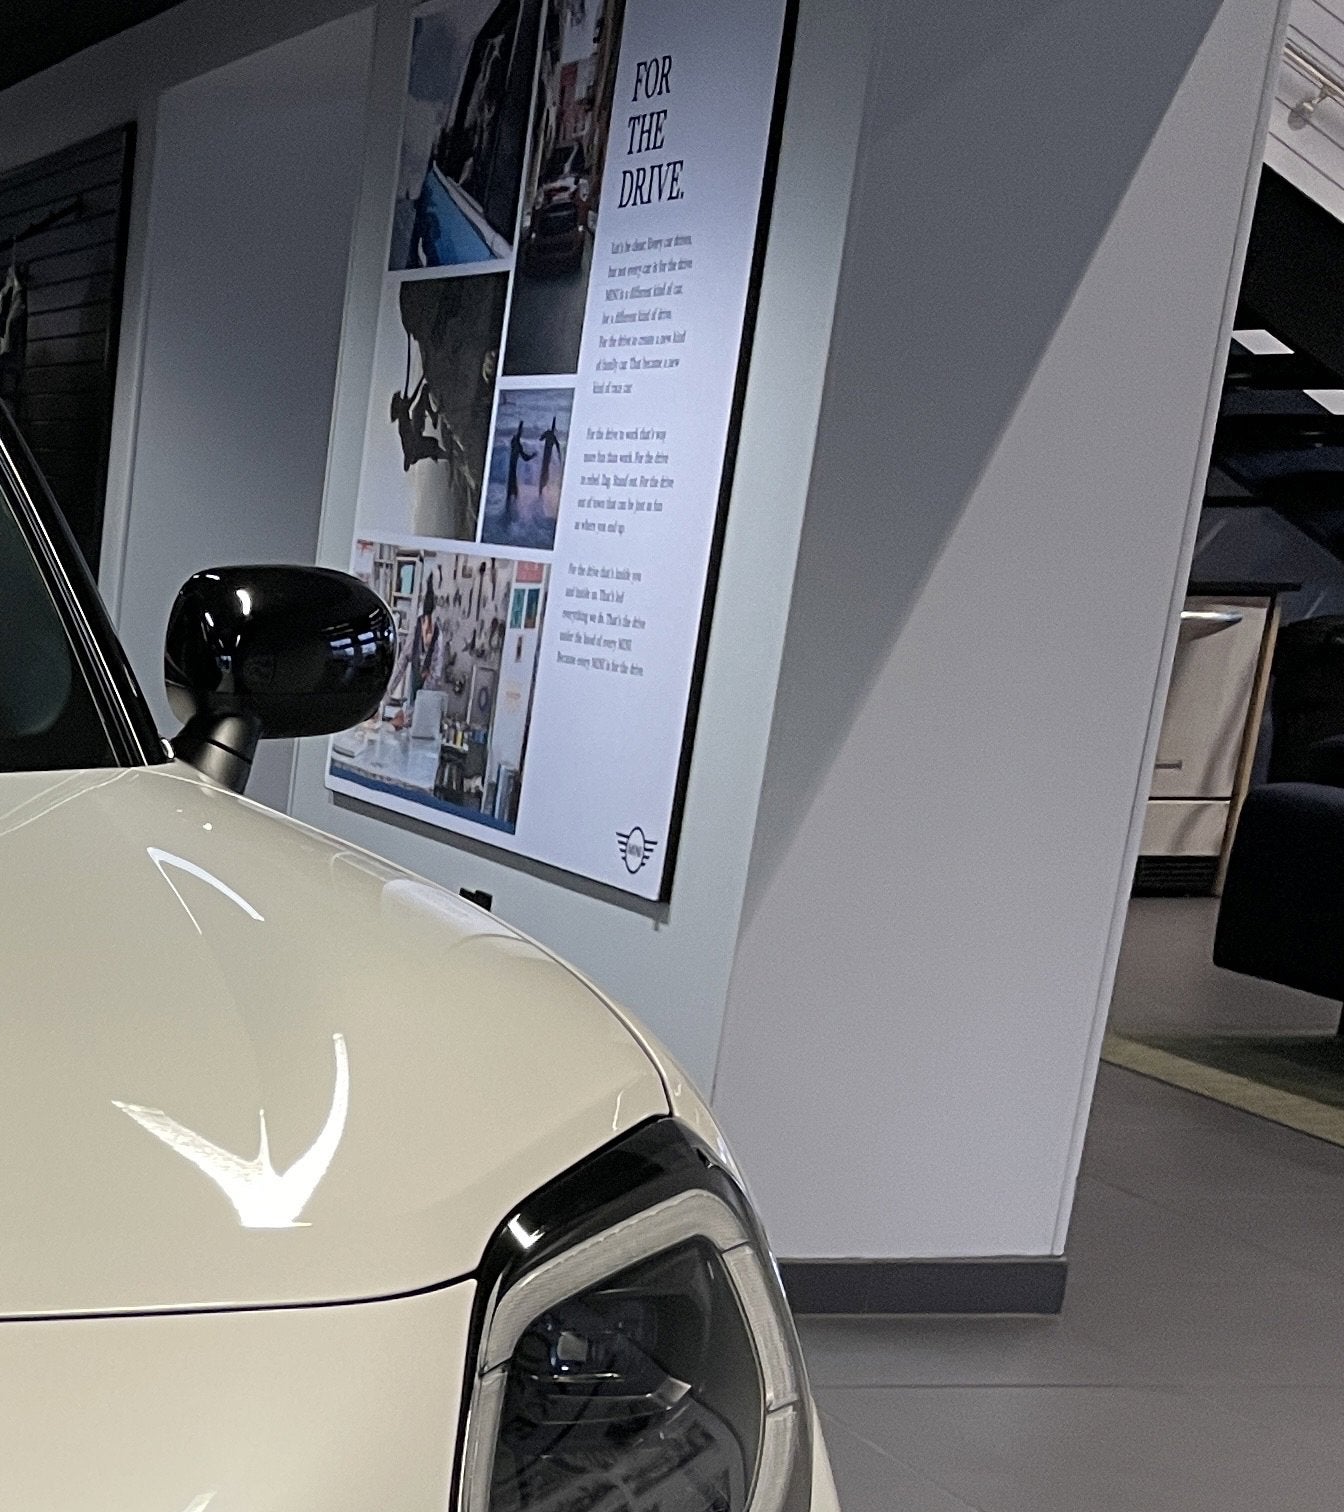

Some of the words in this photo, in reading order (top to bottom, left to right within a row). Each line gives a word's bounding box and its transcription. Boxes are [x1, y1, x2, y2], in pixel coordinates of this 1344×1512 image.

[632, 55, 672, 101] FOR
[627, 109, 668, 155] THE
[618, 160, 684, 208] DRIVE.
